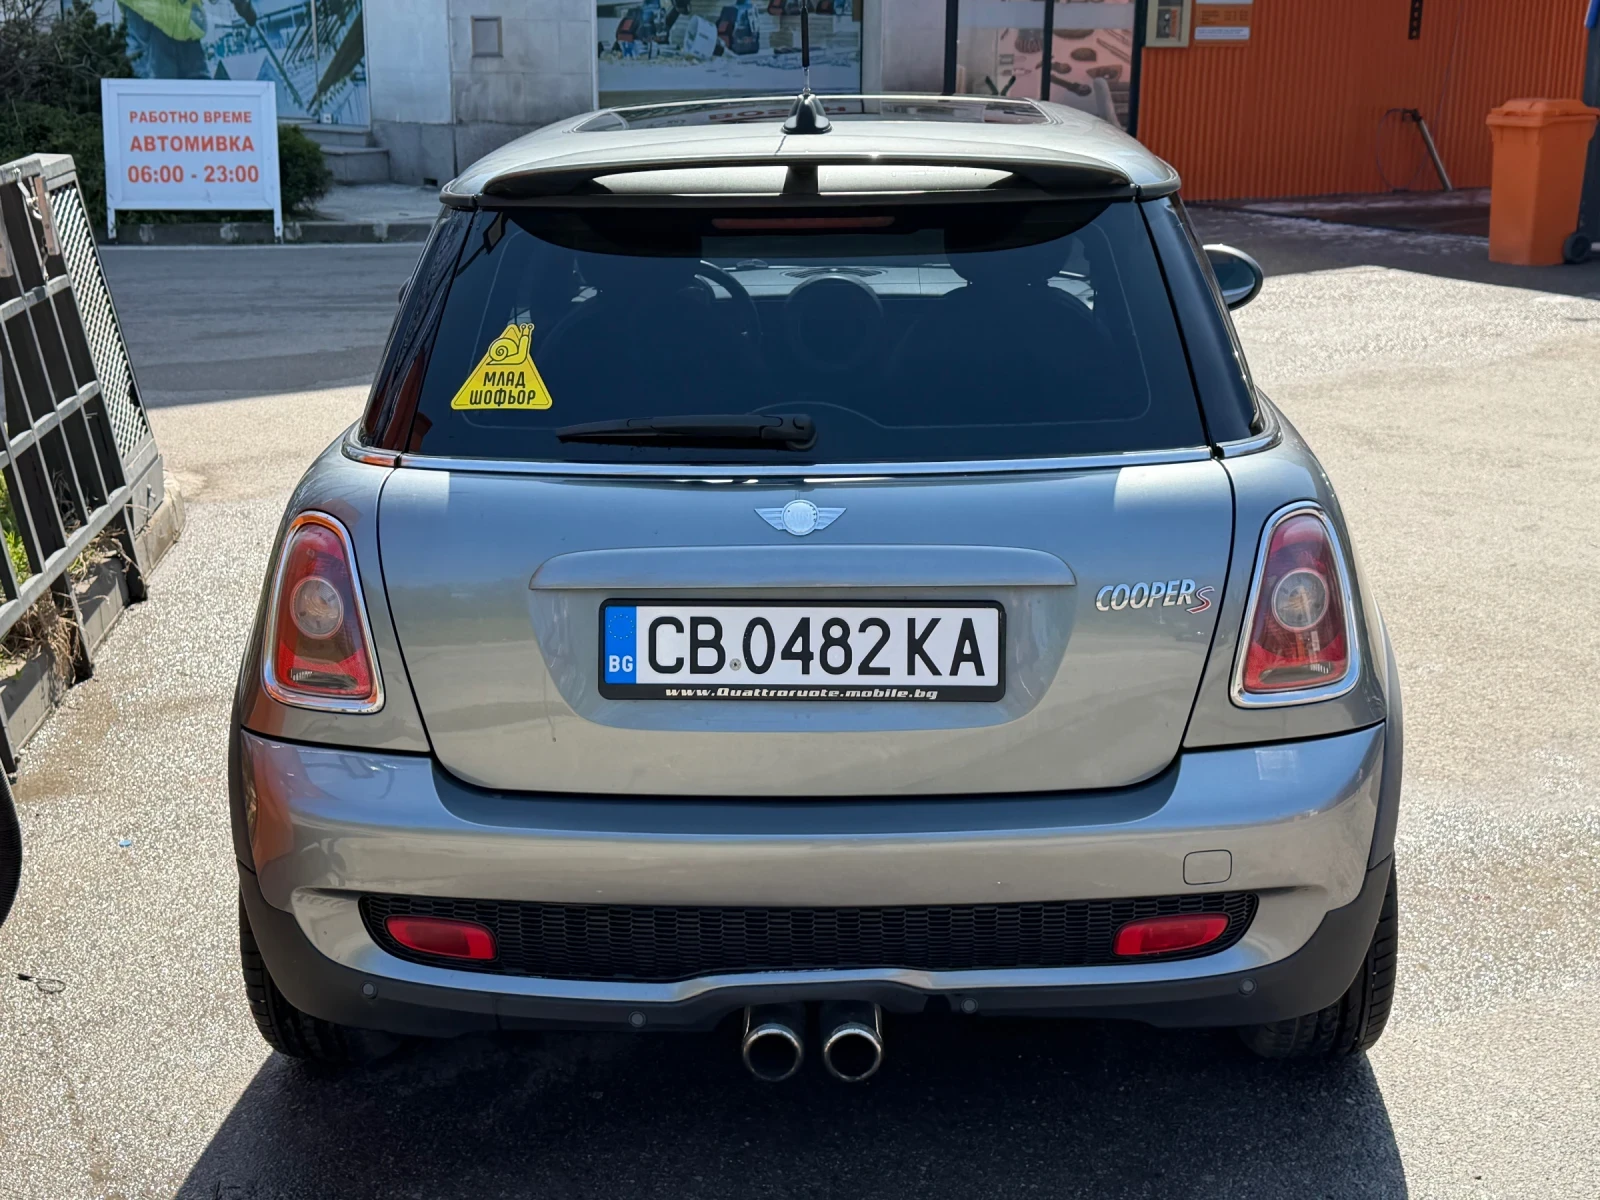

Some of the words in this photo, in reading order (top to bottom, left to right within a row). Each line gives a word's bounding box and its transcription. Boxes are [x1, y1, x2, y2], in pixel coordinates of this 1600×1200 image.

[129, 111, 199, 123] РАБОТНО
[203, 111, 252, 123] ВРЕМЕ
[130, 136, 255, 152] АВТОМИВКА
[127, 165, 184, 183] 06:00
[203, 165, 259, 183] 23:00
[483, 371, 526, 388] МЛАД
[469, 388, 536, 407] ШОФЬОР
[1095, 578, 1196, 612] COOPER
[1186, 585, 1215, 614] S
[648, 616, 726, 674] CB
[742, 616, 891, 676] 0482
[907, 617, 985, 676] KA
[608, 655, 634, 673] BG
[665, 687, 938, 700] www.Quattroruote.mobile.bg
